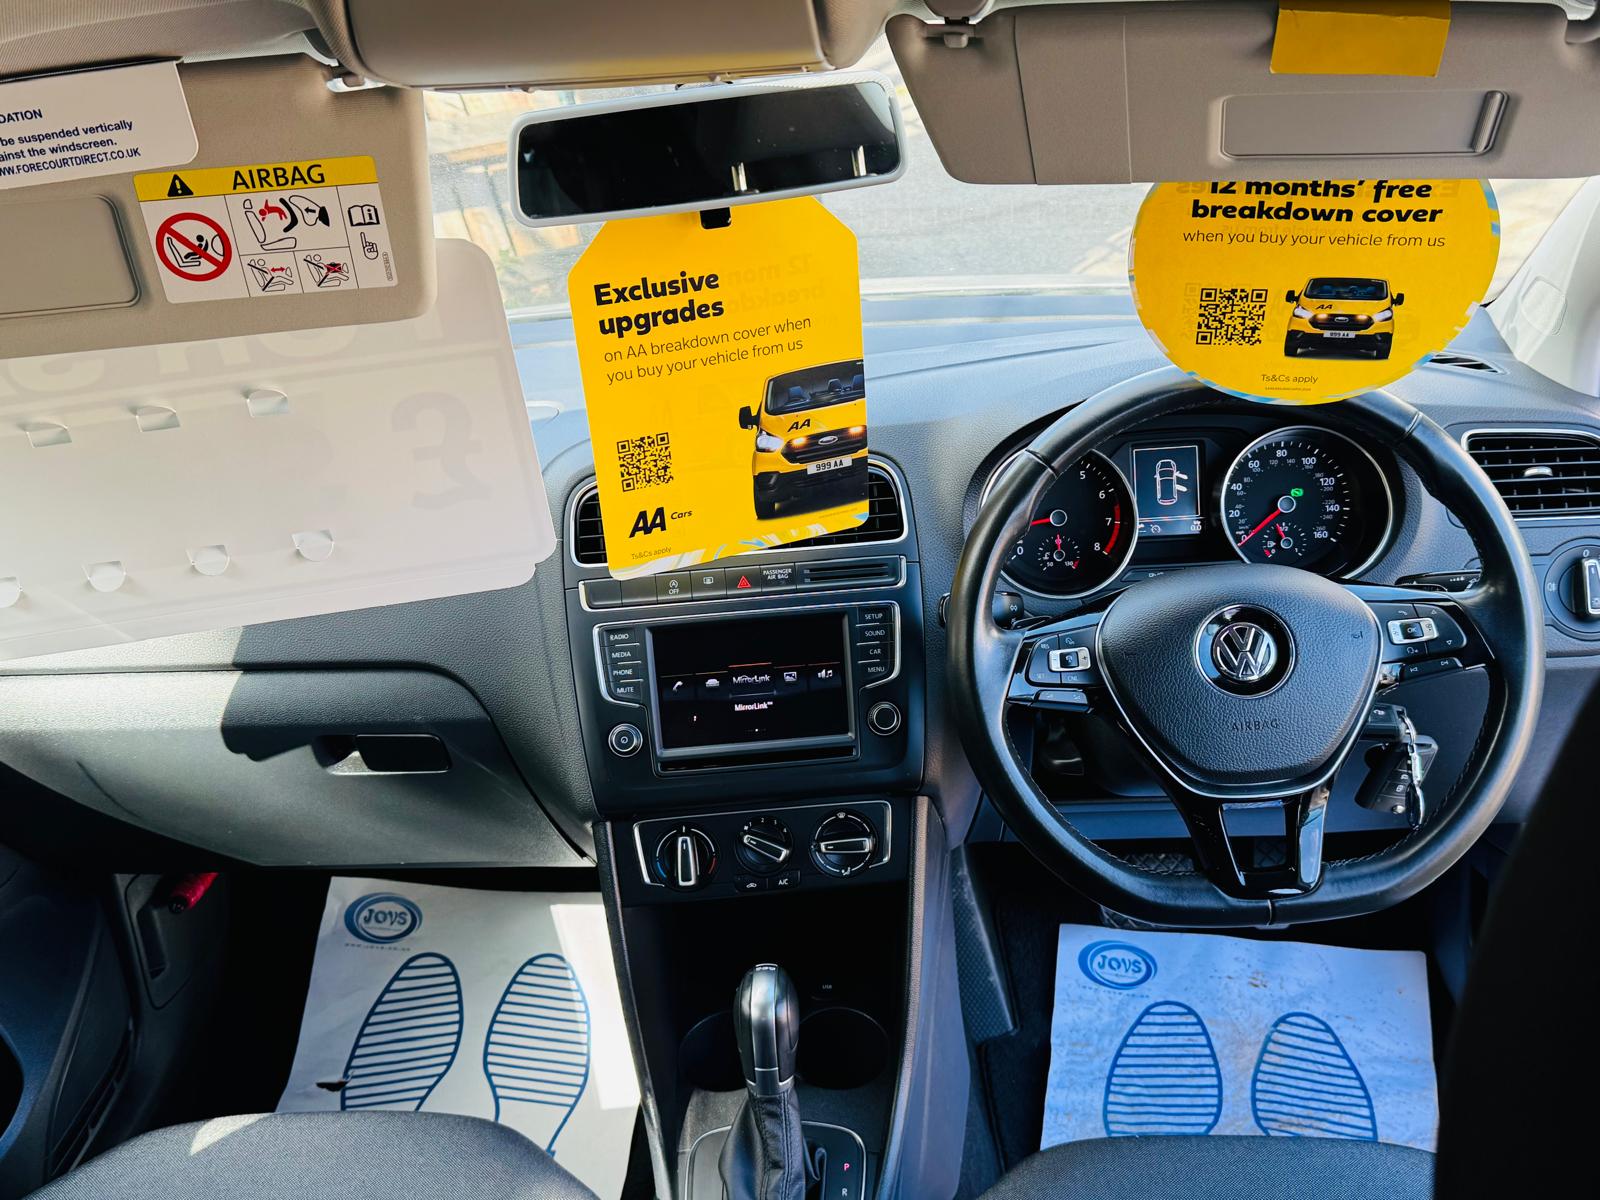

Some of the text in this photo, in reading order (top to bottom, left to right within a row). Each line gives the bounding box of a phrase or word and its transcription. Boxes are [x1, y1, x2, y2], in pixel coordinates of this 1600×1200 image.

[0, 120, 133, 147] be suspended vertically
[27, 147, 47, 158] the
[49, 138, 118, 155] windscreen.
[233, 164, 325, 190] AIRBAG
[1211, 181, 1236, 194] 12
[1373, 180, 1432, 203] free
[1191, 199, 1443, 222] breakdown cover
[1183, 230, 1445, 247] when you buy your vehicle from us
[594, 270, 719, 306] Exclusive
[599, 299, 725, 338] upgrades
[604, 318, 811, 363] on AA breakdown cover when
[606, 340, 804, 386] you buy your vehicle from us
[1261, 374, 1319, 384] Ts&Cs apply
[787, 418, 811, 432] AA
[815, 459, 844, 471] 999 AA
[1248, 460, 1260, 469] 60
[1302, 457, 1316, 465] 100
[1080, 471, 1086, 480] 5
[1320, 478, 1335, 486] 120
[1231, 483, 1242, 491] 40
[1099, 491, 1106, 499] 6
[1325, 504, 1340, 512] 140
[629, 506, 693, 538] AA Cars
[1105, 518, 1112, 526] 7
[1313, 531, 1328, 539] 160
[653, 546, 672, 556] apply
[1016, 546, 1024, 555] 0
[1094, 542, 1101, 551] 8
[763, 568, 792, 576] PASSENGER
[610, 633, 629, 641] RADIO
[864, 629, 886, 637] SOUND
[611, 651, 632, 659] MEDIA
[612, 668, 633, 676] PHONE
[732, 674, 771, 684] MirrorLink
[616, 686, 635, 694] MUTE
[1231, 719, 1280, 732] AIRBAG
[778, 878, 789, 886] A/C
[843, 1162, 850, 1171] P
[841, 1187, 848, 1197] R
